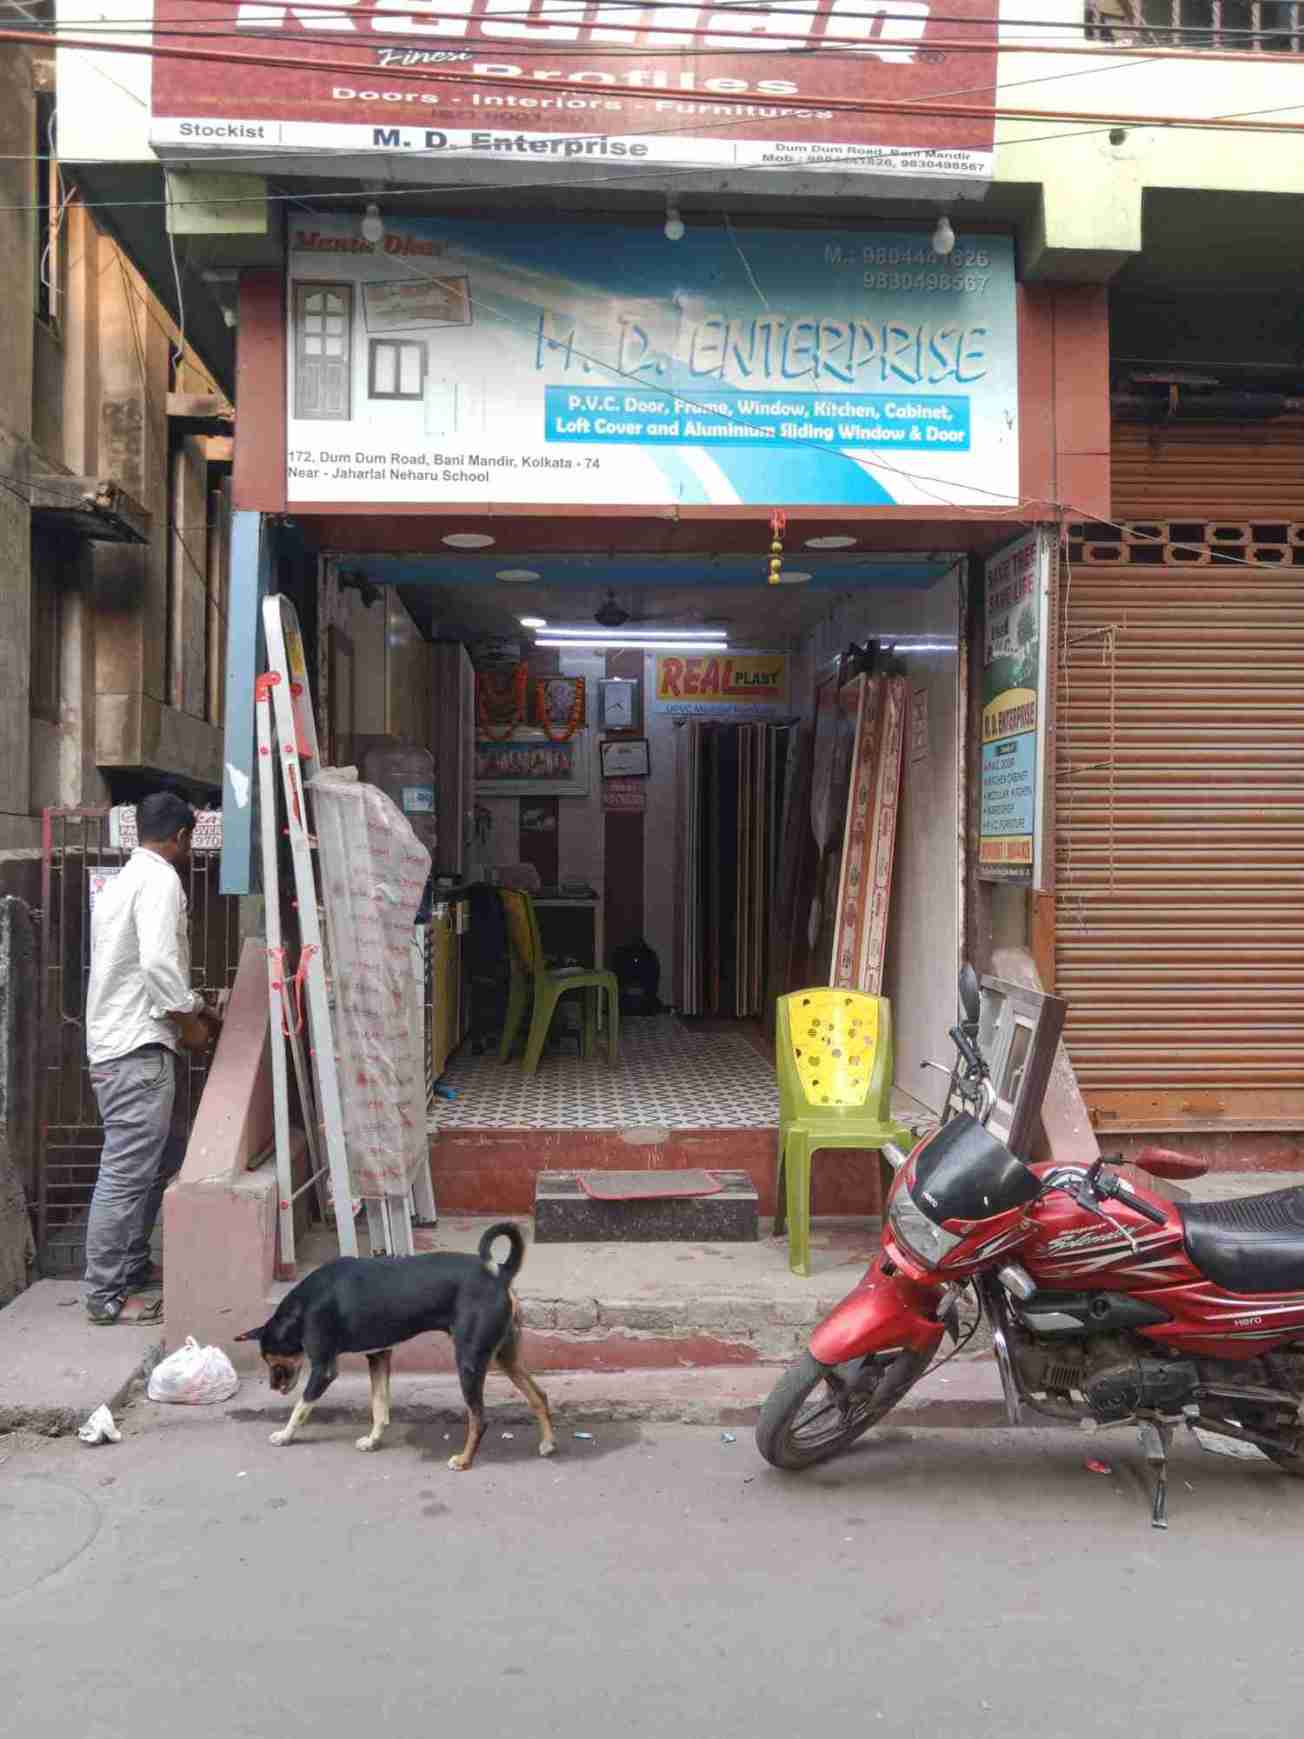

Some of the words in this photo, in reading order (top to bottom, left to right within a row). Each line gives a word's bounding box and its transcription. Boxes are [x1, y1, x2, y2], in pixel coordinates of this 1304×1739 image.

[473, 64, 799, 95] Profiles
[332, 87, 439, 104] Doors
[473, 91, 622, 111] Interiors
[656, 100, 833, 120] Furnitures
[179, 123, 265, 139] Stockist
[372, 128, 411, 148] M.
[425, 130, 457, 150] D.
[471, 132, 648, 157] Enterprise
[762, 153, 793, 162] Mob
[776, 143, 807, 152] Dum
[811, 144, 843, 154] Dum
[924, 149, 971, 161] Mandir
[687, 315, 988, 385] ENTERPRISE
[568, 395, 621, 412] P.V.C.
[624, 398, 670, 416] Door,
[674, 399, 734, 417] Frame,
[737, 400, 808, 418] Window,
[813, 402, 880, 420] Kitchen,
[884, 403, 954, 421] Cabinet,
[556, 416, 591, 434] Loft
[594, 417, 642, 435] Cover
[646, 419, 679, 436] and
[780, 423, 834, 442] Sliding
[838, 424, 905, 441] Window
[909, 426, 922, 441] &
[925, 427, 966, 443] Door
[287, 452, 316, 464] 172,
[320, 452, 351, 464] Dum
[355, 453, 387, 465] Dum
[391, 453, 430, 466] Road,
[434, 454, 465, 466] Bani
[468, 454, 518, 469] Mandir,
[521, 456, 573, 469] Kolkata
[585, 457, 601, 469] 74
[287, 468, 320, 480] Near
[332, 468, 386, 481] Jaharlal
[390, 469, 438, 482] Neharu
[442, 470, 490, 483] School
[660, 656, 736, 697] REAL
